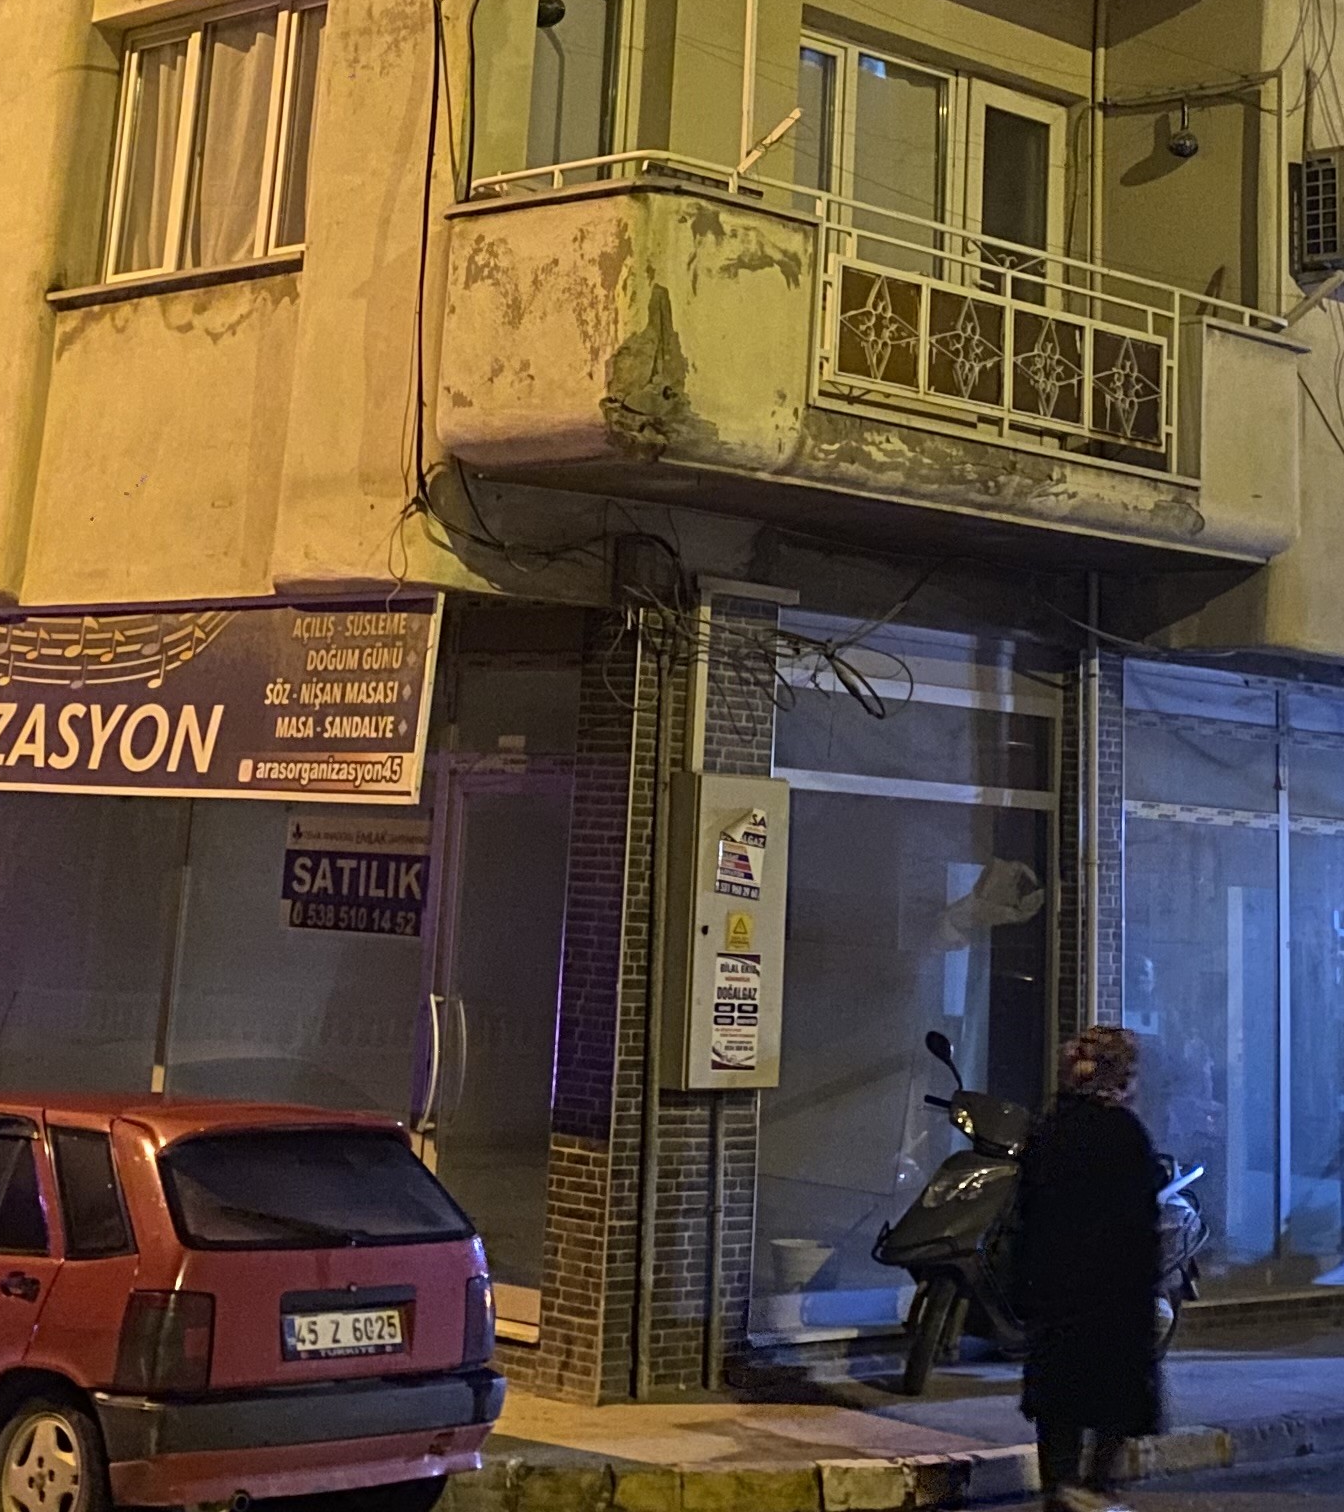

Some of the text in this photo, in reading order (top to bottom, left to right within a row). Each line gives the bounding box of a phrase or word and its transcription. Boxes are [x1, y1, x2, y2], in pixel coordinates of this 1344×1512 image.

[293, 616, 336, 643] AÇILIŞ
[306, 641, 404, 671] DOĞUM GÜNÜ
[264, 678, 291, 705] SÖZ
[299, 677, 343, 710] NİŞAN
[344, 680, 399, 704] MASASI
[275, 716, 314, 738] MASA
[323, 715, 395, 738] SANDALYE
[255, 757, 402, 786] arasorganizasyon45
[291, 856, 422, 901] SATILIK
[292, 900, 416, 934] 0 538 510 14 52
[296, 1314, 398, 1346] 45 Z 6025
